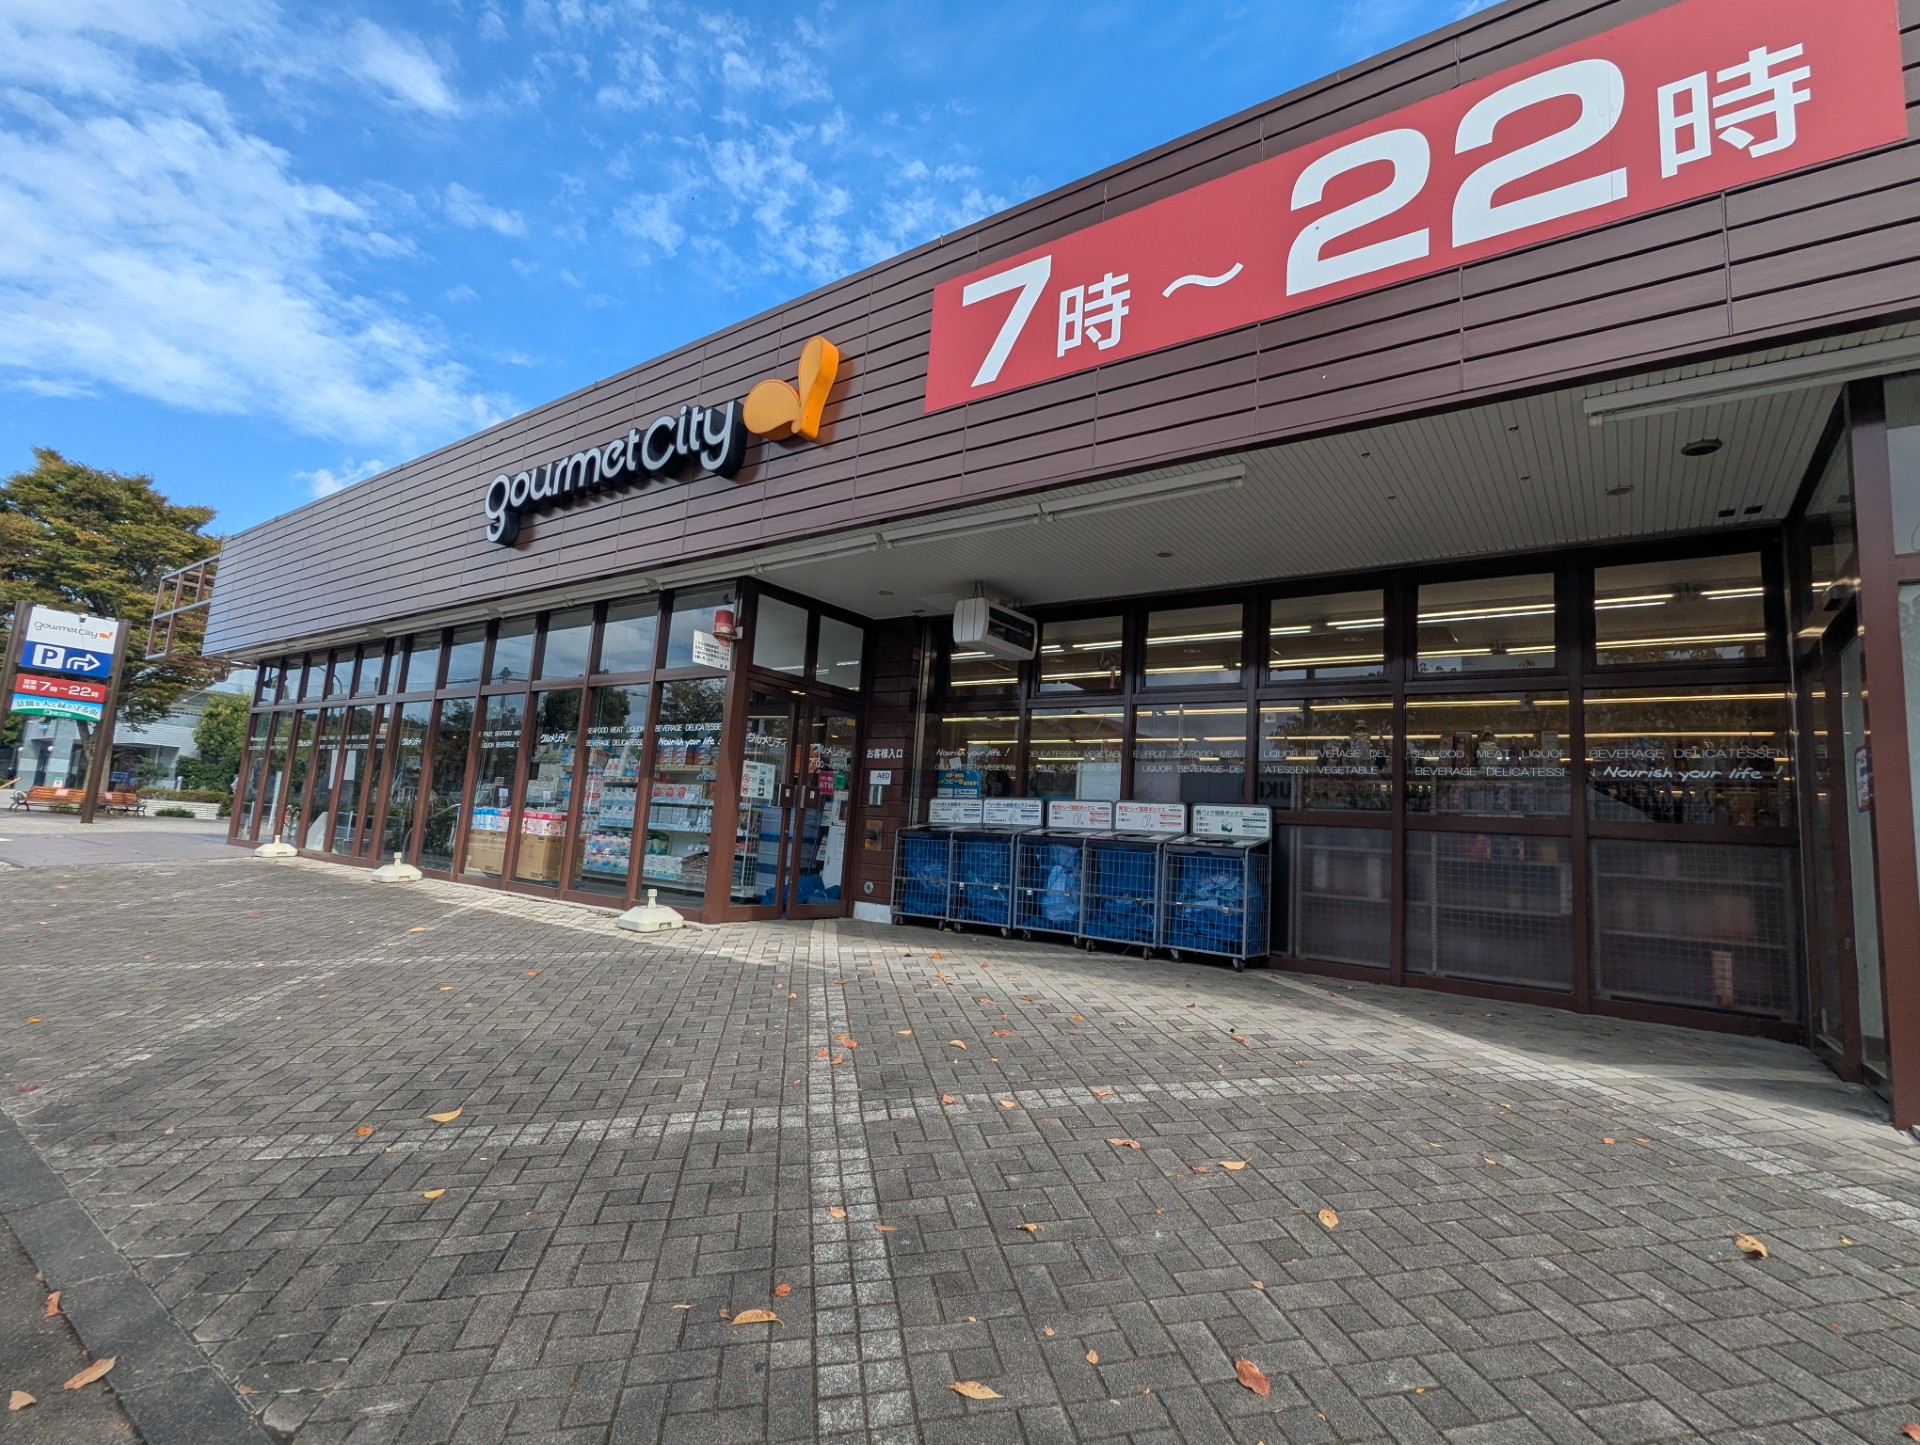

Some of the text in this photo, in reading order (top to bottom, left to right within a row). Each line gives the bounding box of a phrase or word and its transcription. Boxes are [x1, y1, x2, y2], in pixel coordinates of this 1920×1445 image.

[485, 400, 740, 545] gourmetCity
[33, 621, 98, 639] gourmetCity
[40, 648, 58, 665] P
[655, 723, 682, 732] BEVERAGE
[746, 732, 787, 749] グルメシティ
[867, 748, 903, 759] お客様入口
[936, 748, 966, 757] Nourish
[1144, 750, 1167, 758] FRUIT
[1173, 750, 1214, 758] SEAFOOD
[1410, 749, 1465, 759] SEAFOOD
[1477, 749, 1511, 759] MEAT
[1589, 749, 1788, 759] BEVERAGE DELICATESSEN
[1142, 765, 1172, 773] LIQUOR
[1177, 765, 1224, 773] BEVERAGE
[1263, 766, 1378, 775] ATESSEN VEGETABLE
[1415, 767, 1477, 777] BEVERAGE
[1603, 766, 1672, 779] Nourish
[1678, 770, 1721, 782] your
[1728, 768, 1762, 780] life
[820, 781, 834, 789] ATM
